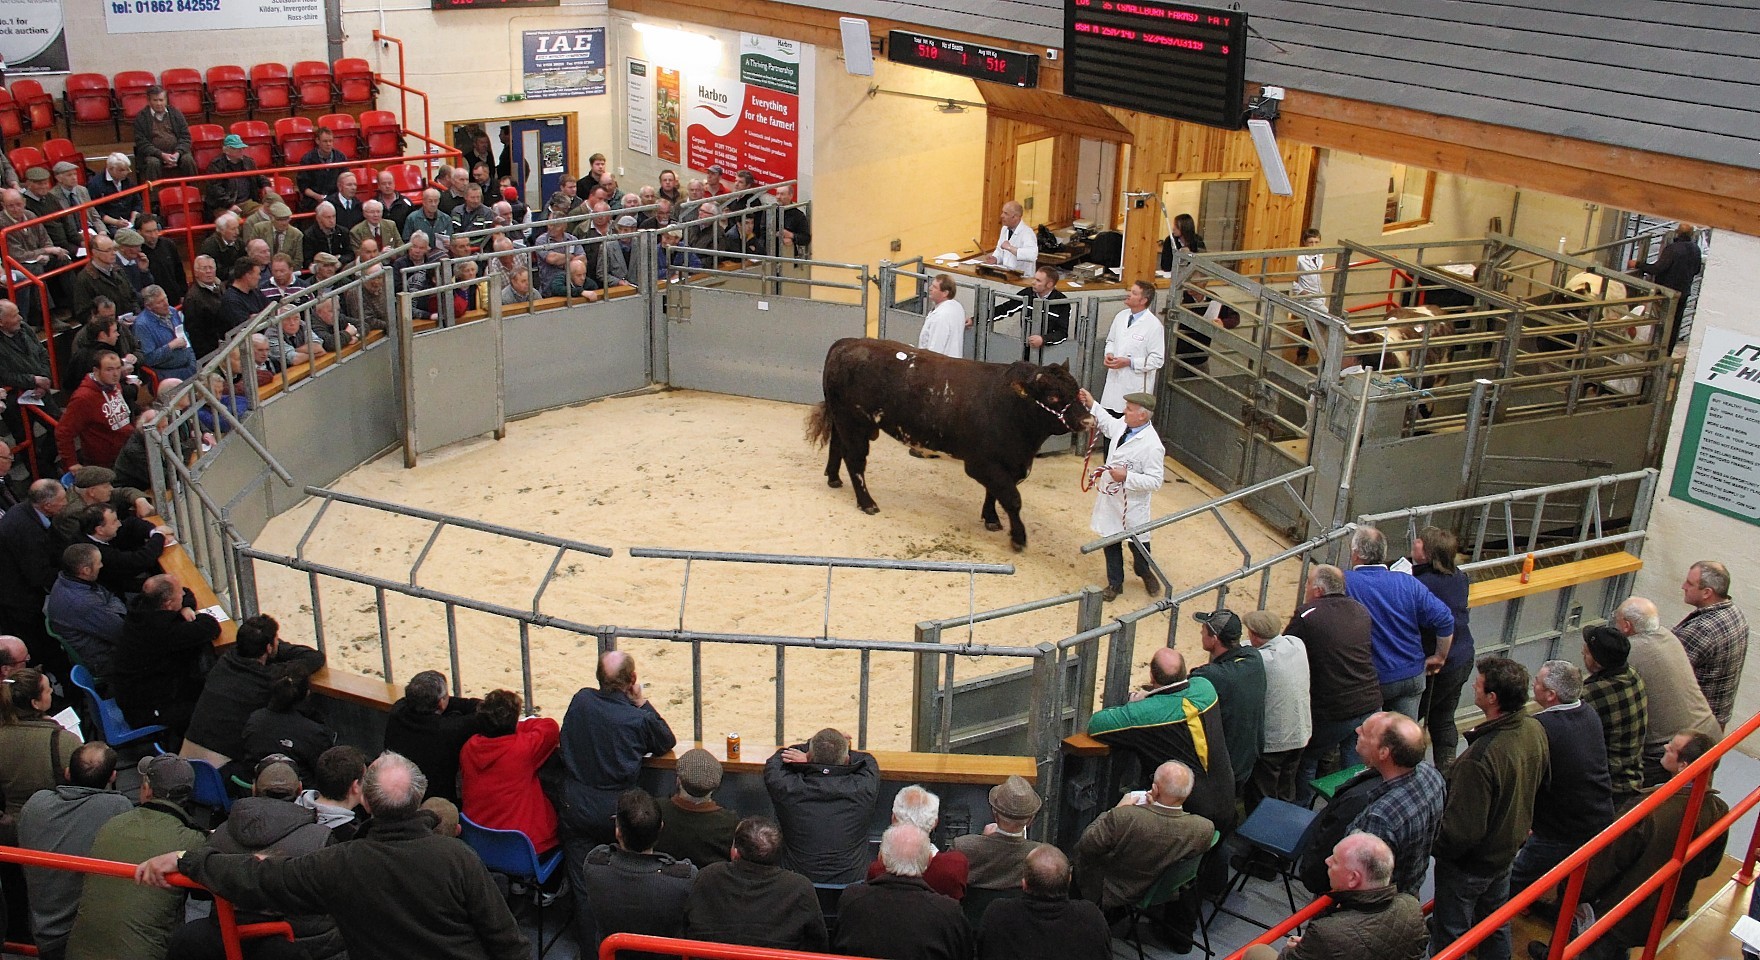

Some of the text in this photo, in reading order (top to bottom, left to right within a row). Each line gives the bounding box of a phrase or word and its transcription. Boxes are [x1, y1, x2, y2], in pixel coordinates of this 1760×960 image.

[112, 0, 221, 14] tel: 01862 842552
[283, 5, 318, 13] Invergordon
[16, 17, 28, 25] for
[15, 26, 49, 35] auctions
[536, 34, 593, 53] IAE
[918, 44, 938, 59] 510
[961, 52, 968, 65] 1
[750, 58, 768, 72] Thriving
[768, 63, 794, 76] Partnership
[699, 85, 728, 104] Harbro
[752, 95, 788, 115] Everything
[745, 109, 795, 131] for the farmer!
